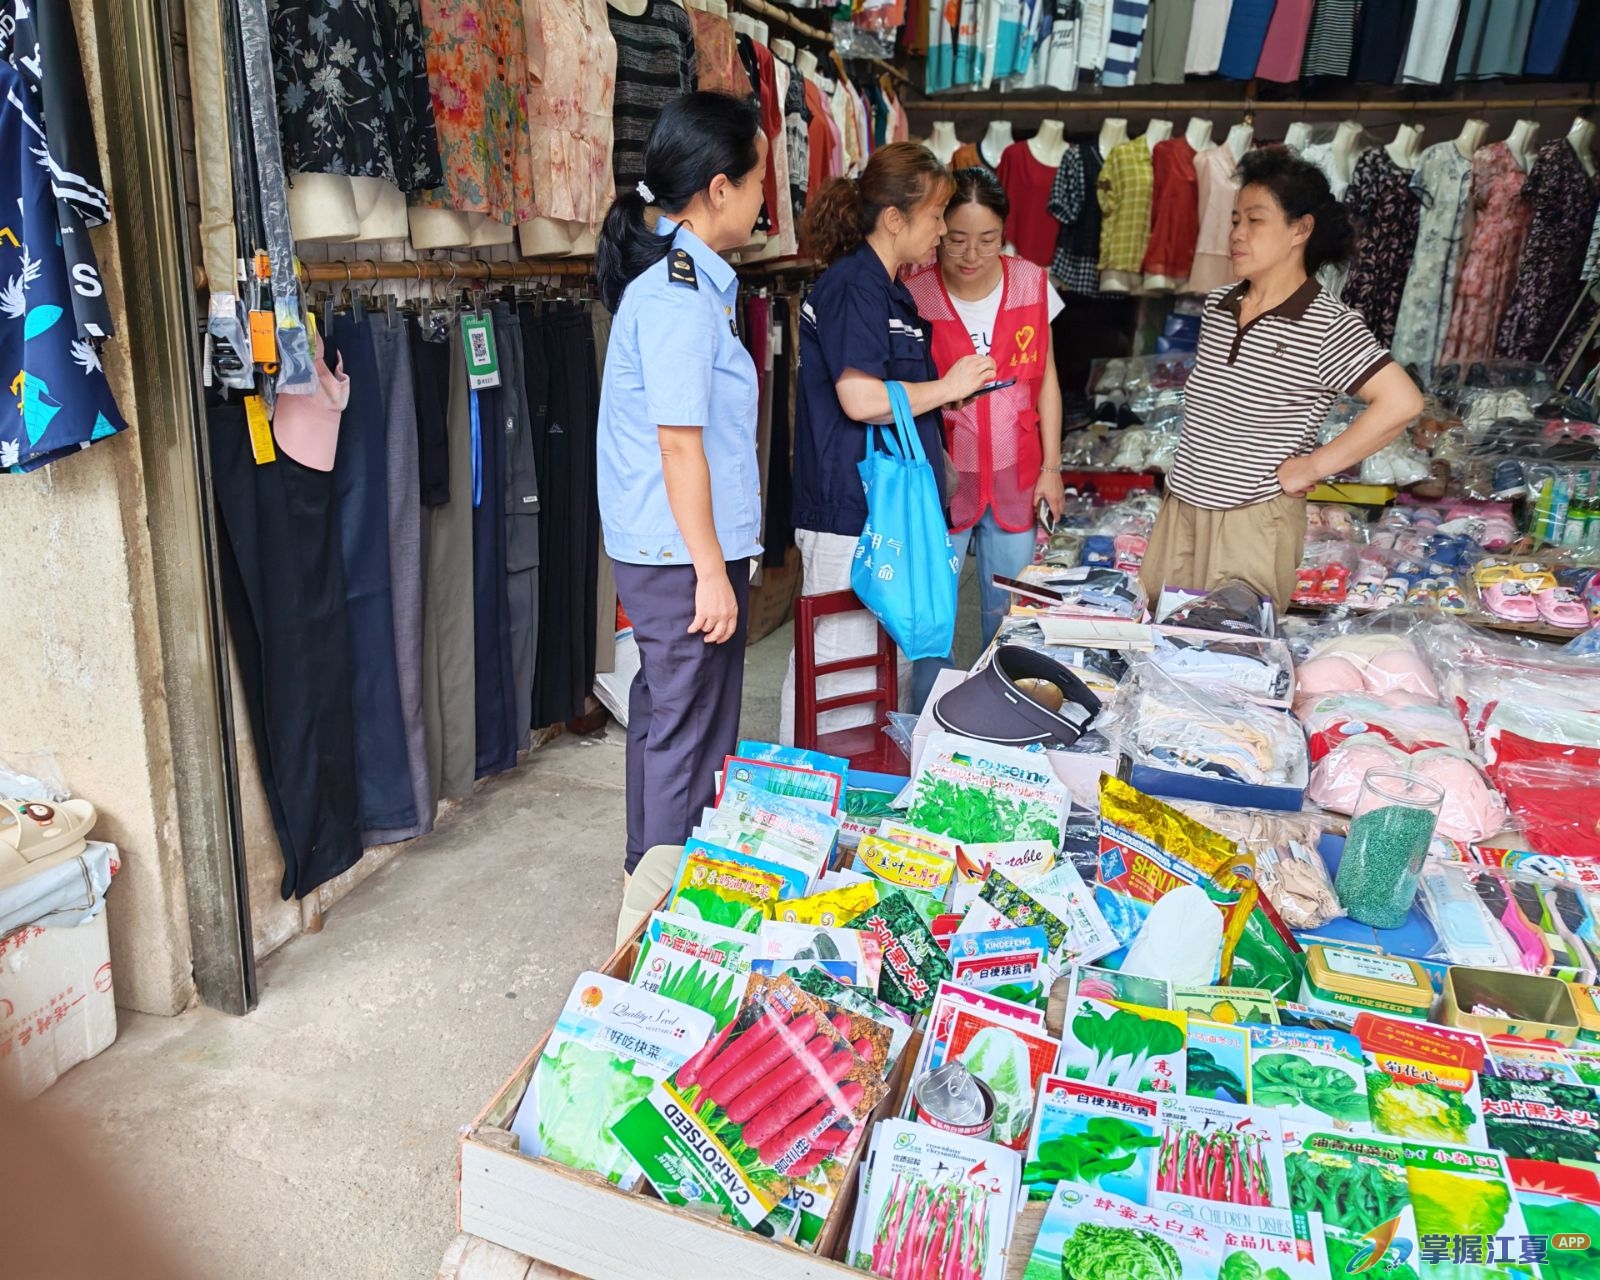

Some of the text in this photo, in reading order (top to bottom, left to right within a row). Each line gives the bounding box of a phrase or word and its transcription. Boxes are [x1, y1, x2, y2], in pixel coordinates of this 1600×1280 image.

[867, 915, 930, 1001] 大叶黑大头
[979, 962, 1033, 980] 白梗矮抗青
[609, 1001, 649, 1024] Quality
[1385, 1060, 1439, 1083] 菊花心
[1075, 1093, 1150, 1118] 白梗矮抗青
[1481, 1098, 1600, 1130] 大叶黑大头
[663, 1102, 752, 1206] CARROTSEED
[1092, 1195, 1210, 1243] 蜂蜜大白菜
[1199, 1204, 1293, 1235] CHILDREN DISHES
[1223, 1231, 1295, 1256] 金品儿菜
